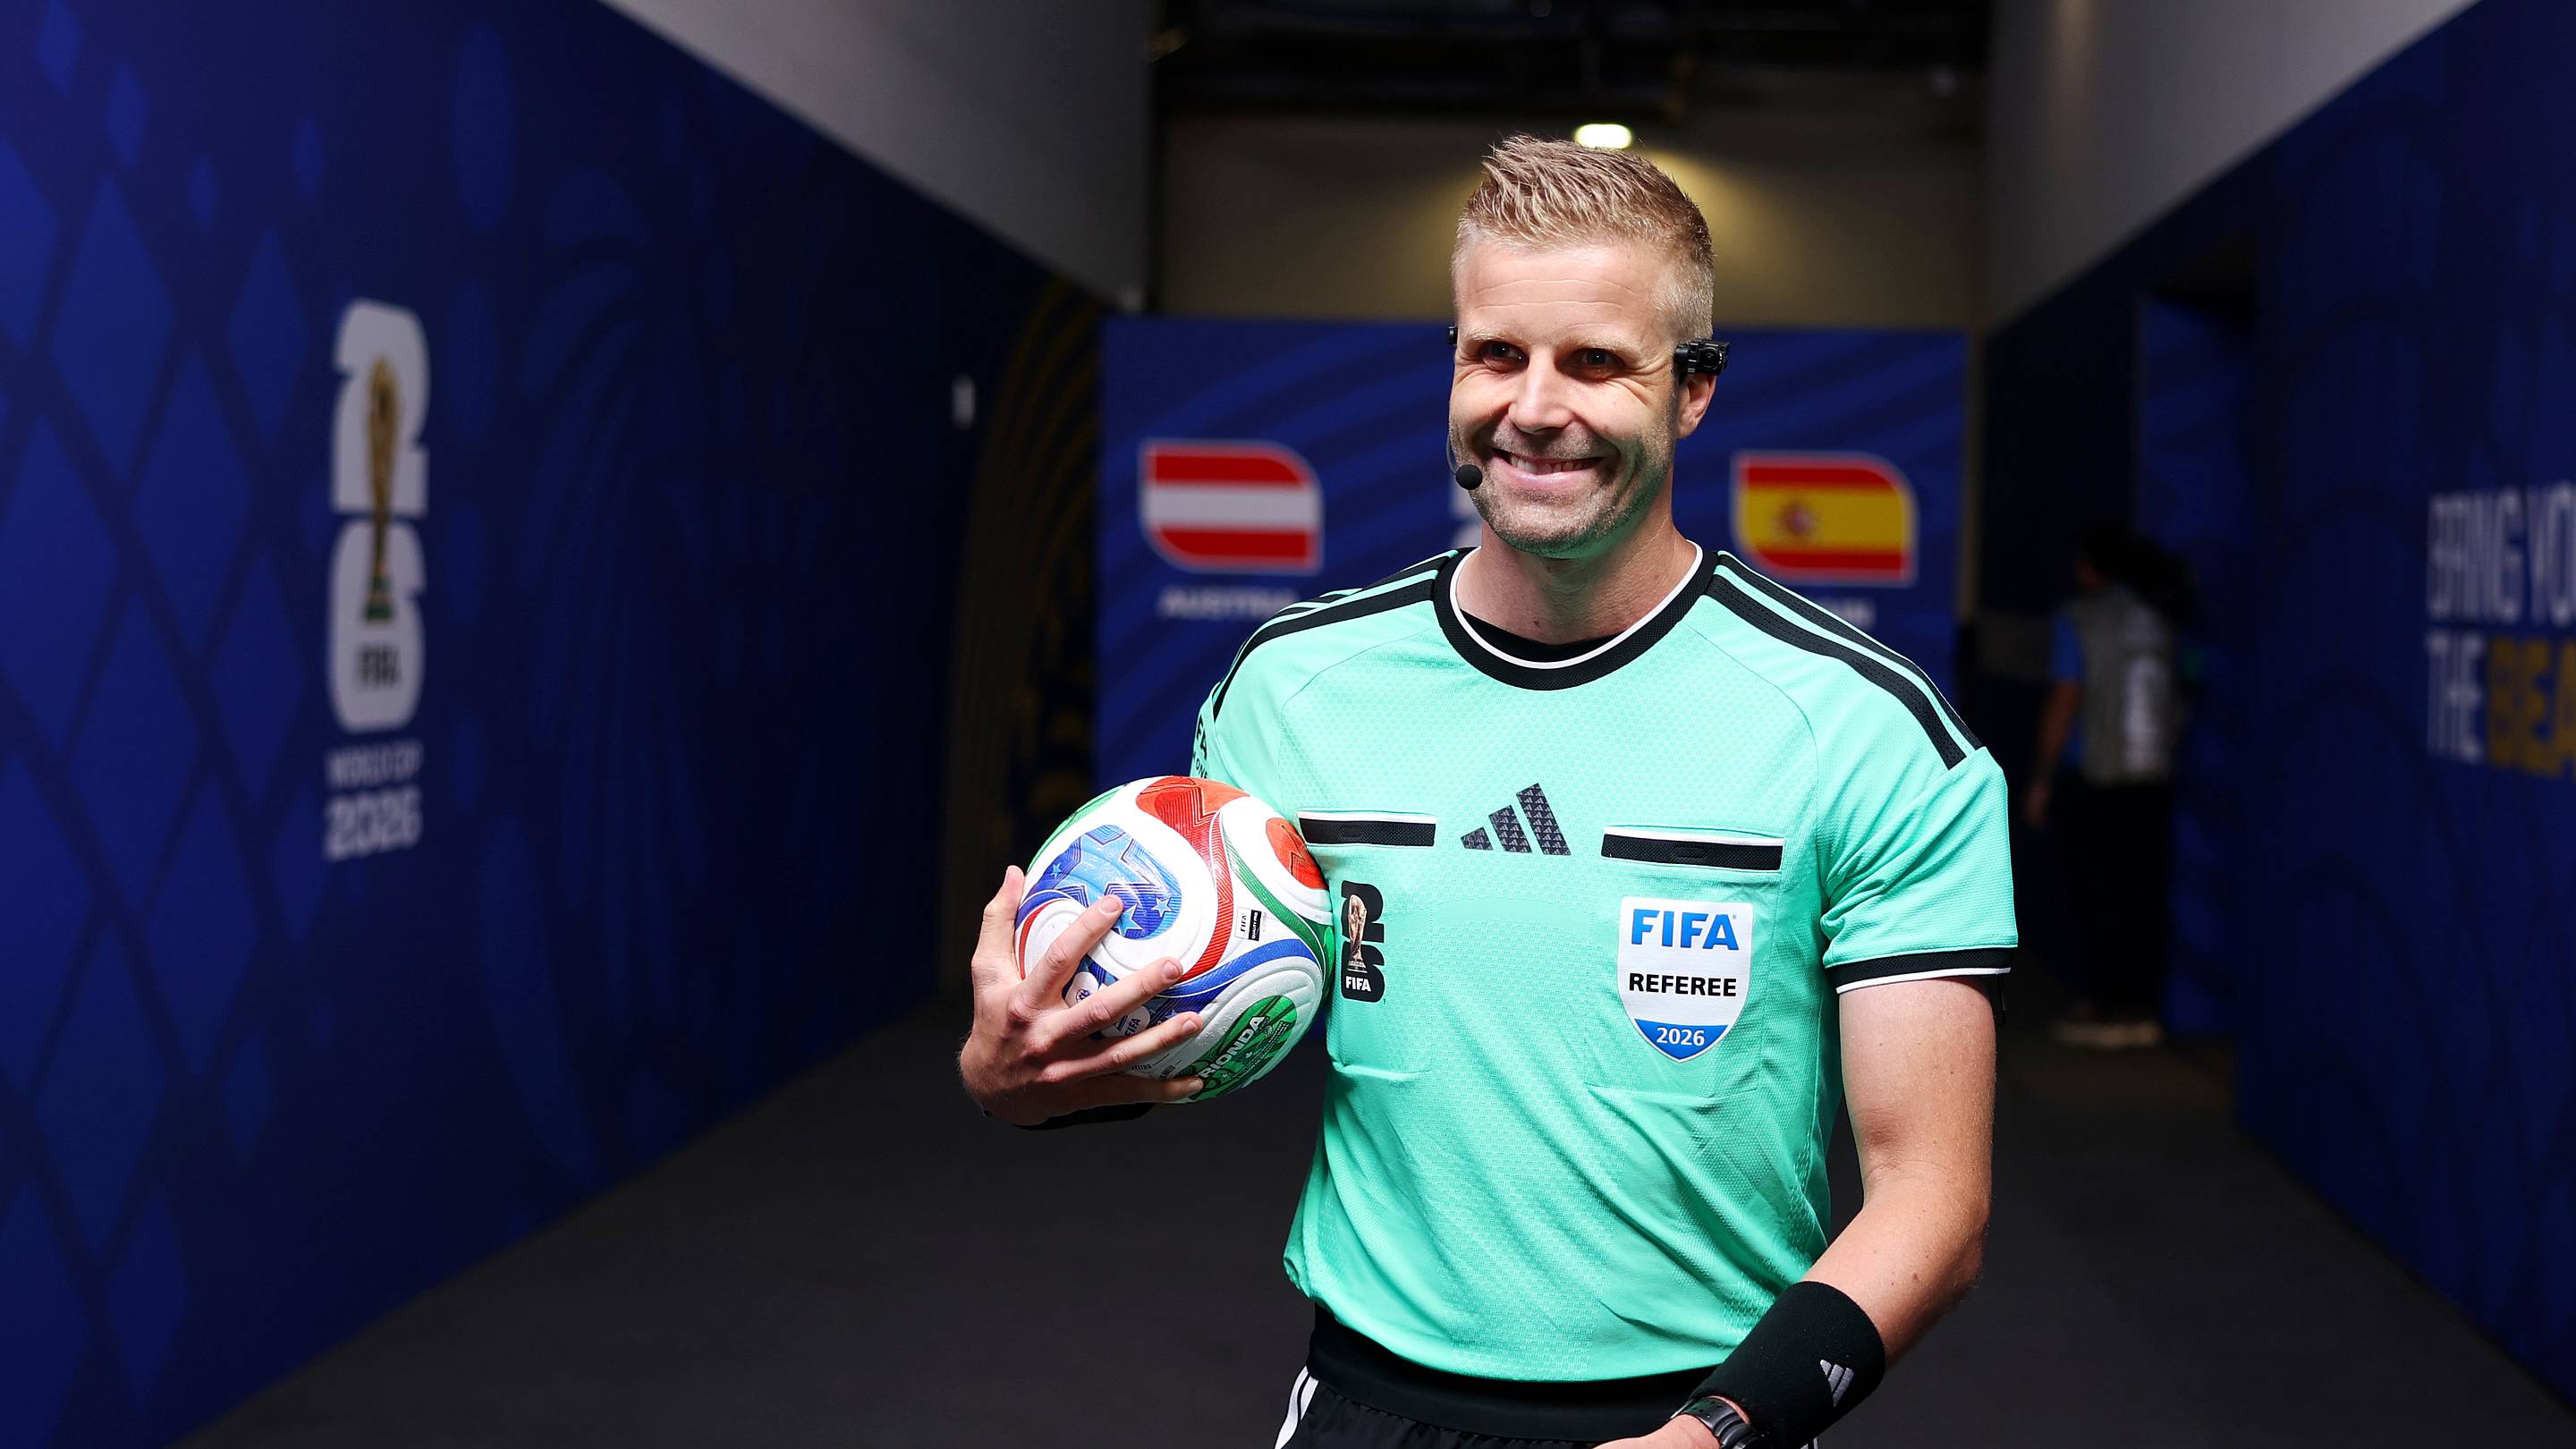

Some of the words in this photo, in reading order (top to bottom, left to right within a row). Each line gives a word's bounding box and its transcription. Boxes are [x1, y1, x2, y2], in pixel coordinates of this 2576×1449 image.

[2425, 630, 2483, 763] THE
[324, 784, 423, 861] 2026
[1631, 909, 1739, 951] FIFA
[1345, 975, 1371, 992] FIFA
[1629, 972, 1737, 997] REFEREE
[1195, 1015, 1267, 1079] RIONDA
[1656, 1027, 1706, 1046] 2026
